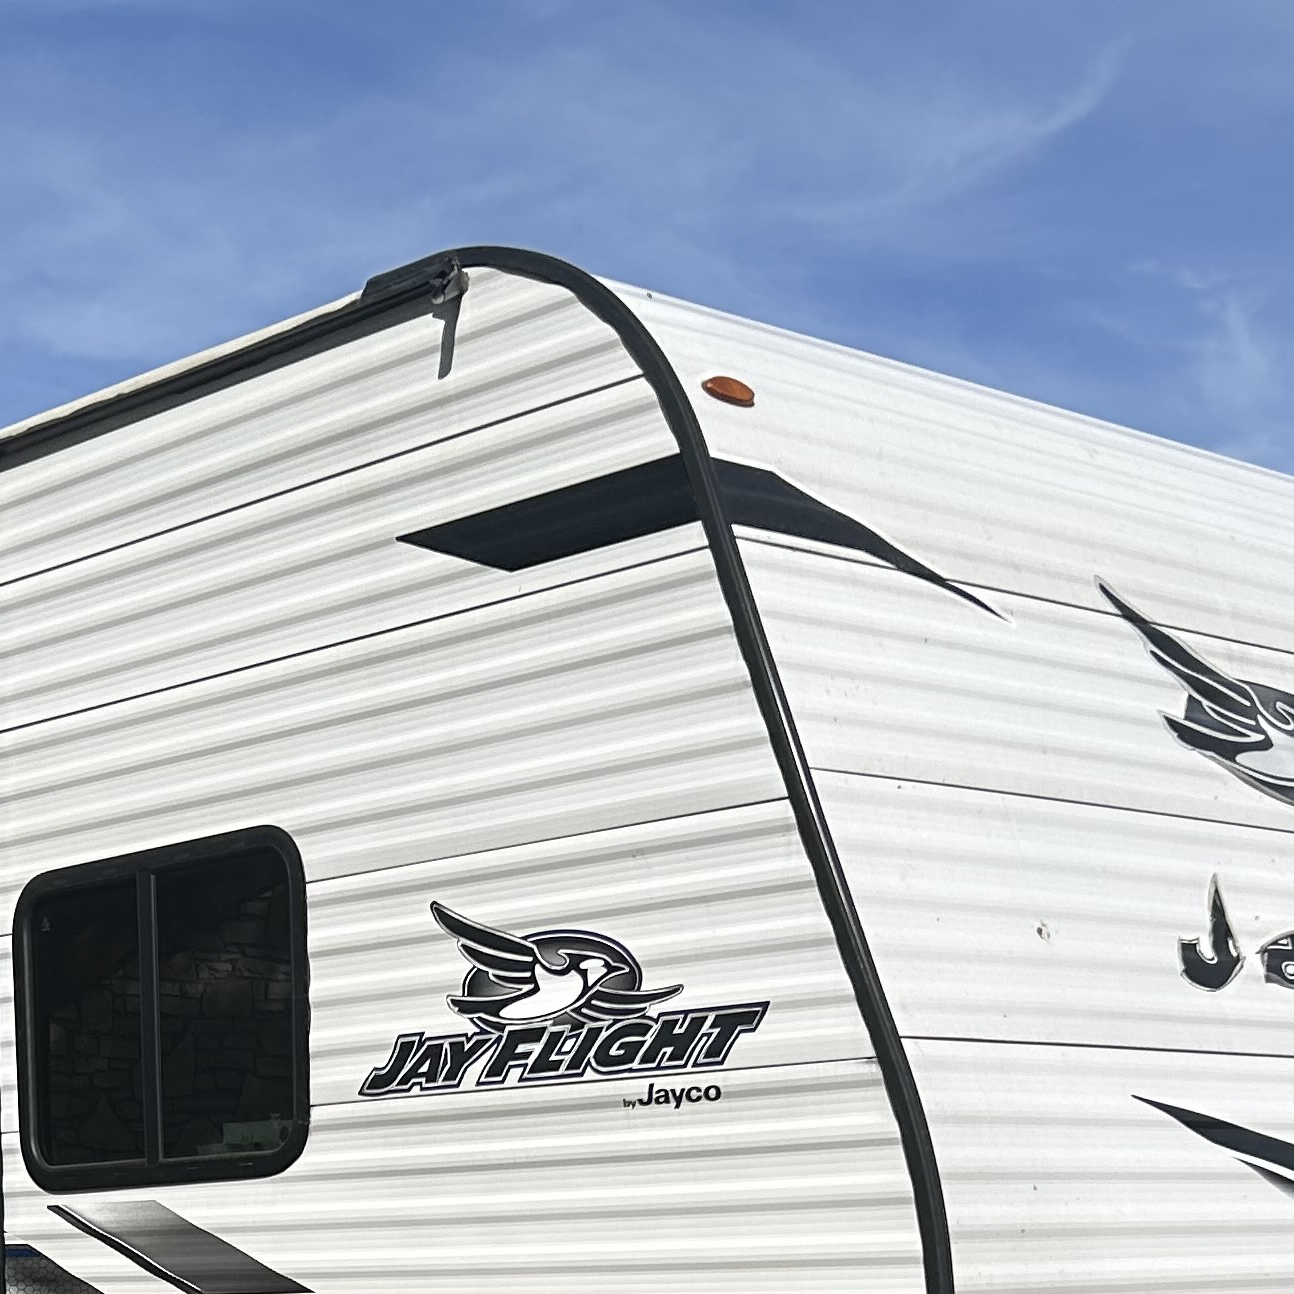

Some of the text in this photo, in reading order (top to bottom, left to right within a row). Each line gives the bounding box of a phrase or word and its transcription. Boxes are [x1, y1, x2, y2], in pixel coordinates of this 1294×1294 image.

[358, 1001, 770, 1096] JAY FLIGHT
[638, 1083, 722, 1109] Jayco
